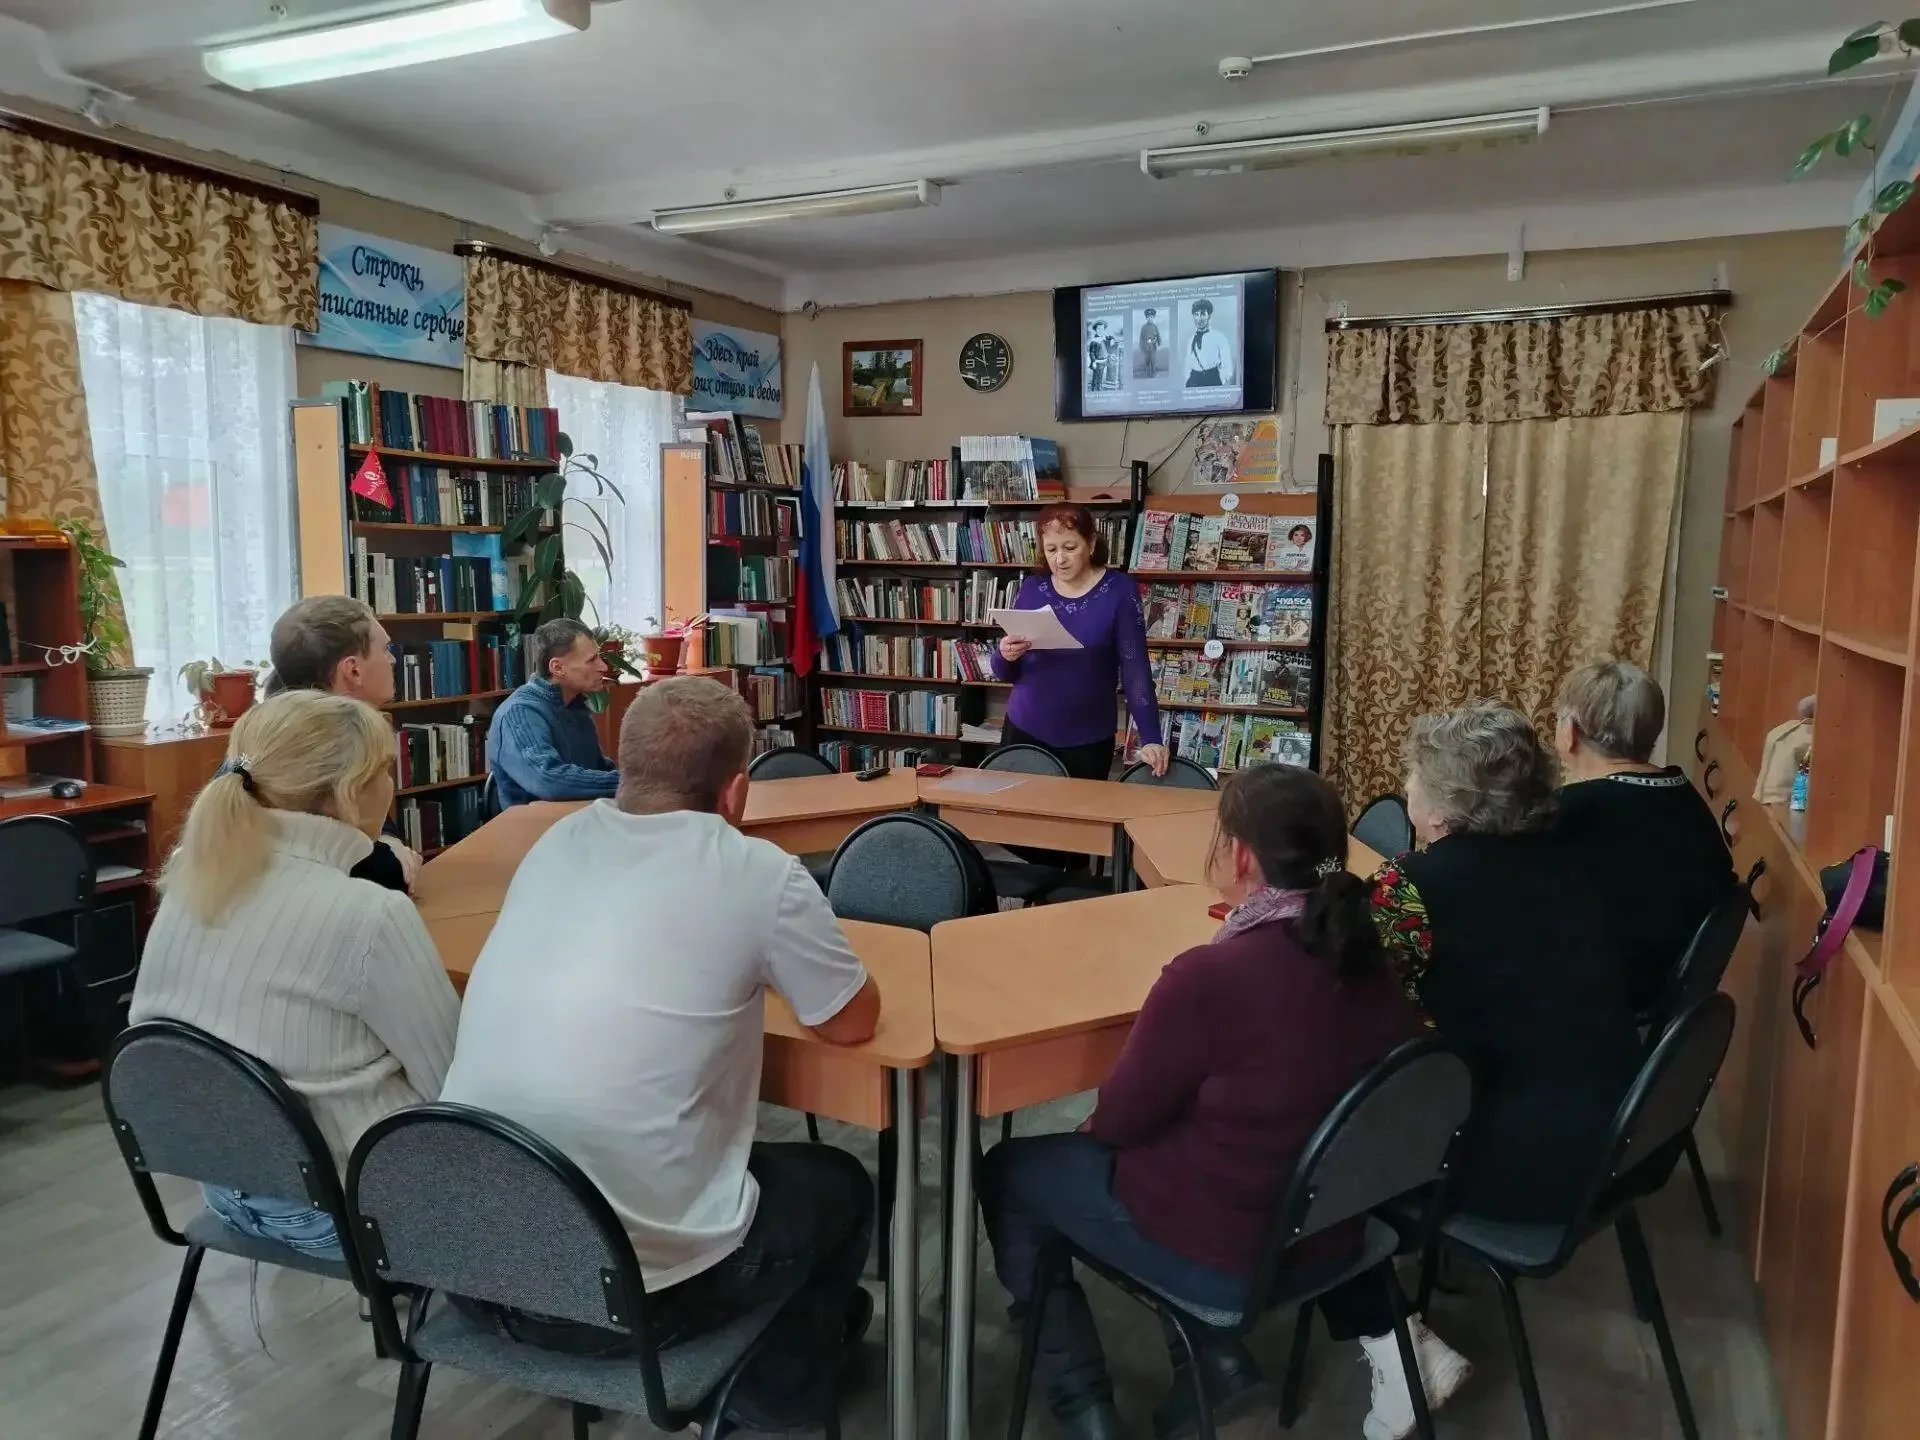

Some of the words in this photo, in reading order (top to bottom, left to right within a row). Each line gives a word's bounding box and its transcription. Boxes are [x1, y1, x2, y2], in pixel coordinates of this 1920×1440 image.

[352, 246, 424, 292] Строки
[317, 292, 409, 327] писанные
[414, 304, 465, 342] сердце
[980, 339, 992, 349] 12
[704, 337, 734, 362] Здесь
[736, 350, 760, 372] край
[965, 358, 976, 369] 9
[996, 357, 1007, 367] 3
[980, 376, 991, 387] 6
[693, 376, 715, 397] оих
[715, 380, 746, 400] отцов
[748, 387, 755, 398] и
[757, 380, 781, 402] дедов
[1229, 513, 1268, 524] ЗАГАДКИ
[1226, 520, 1268, 530] ИСТОРИИ
[1276, 597, 1312, 605] ЧУДЕСА
[1266, 653, 1312, 666] ИСТОРИЯ
